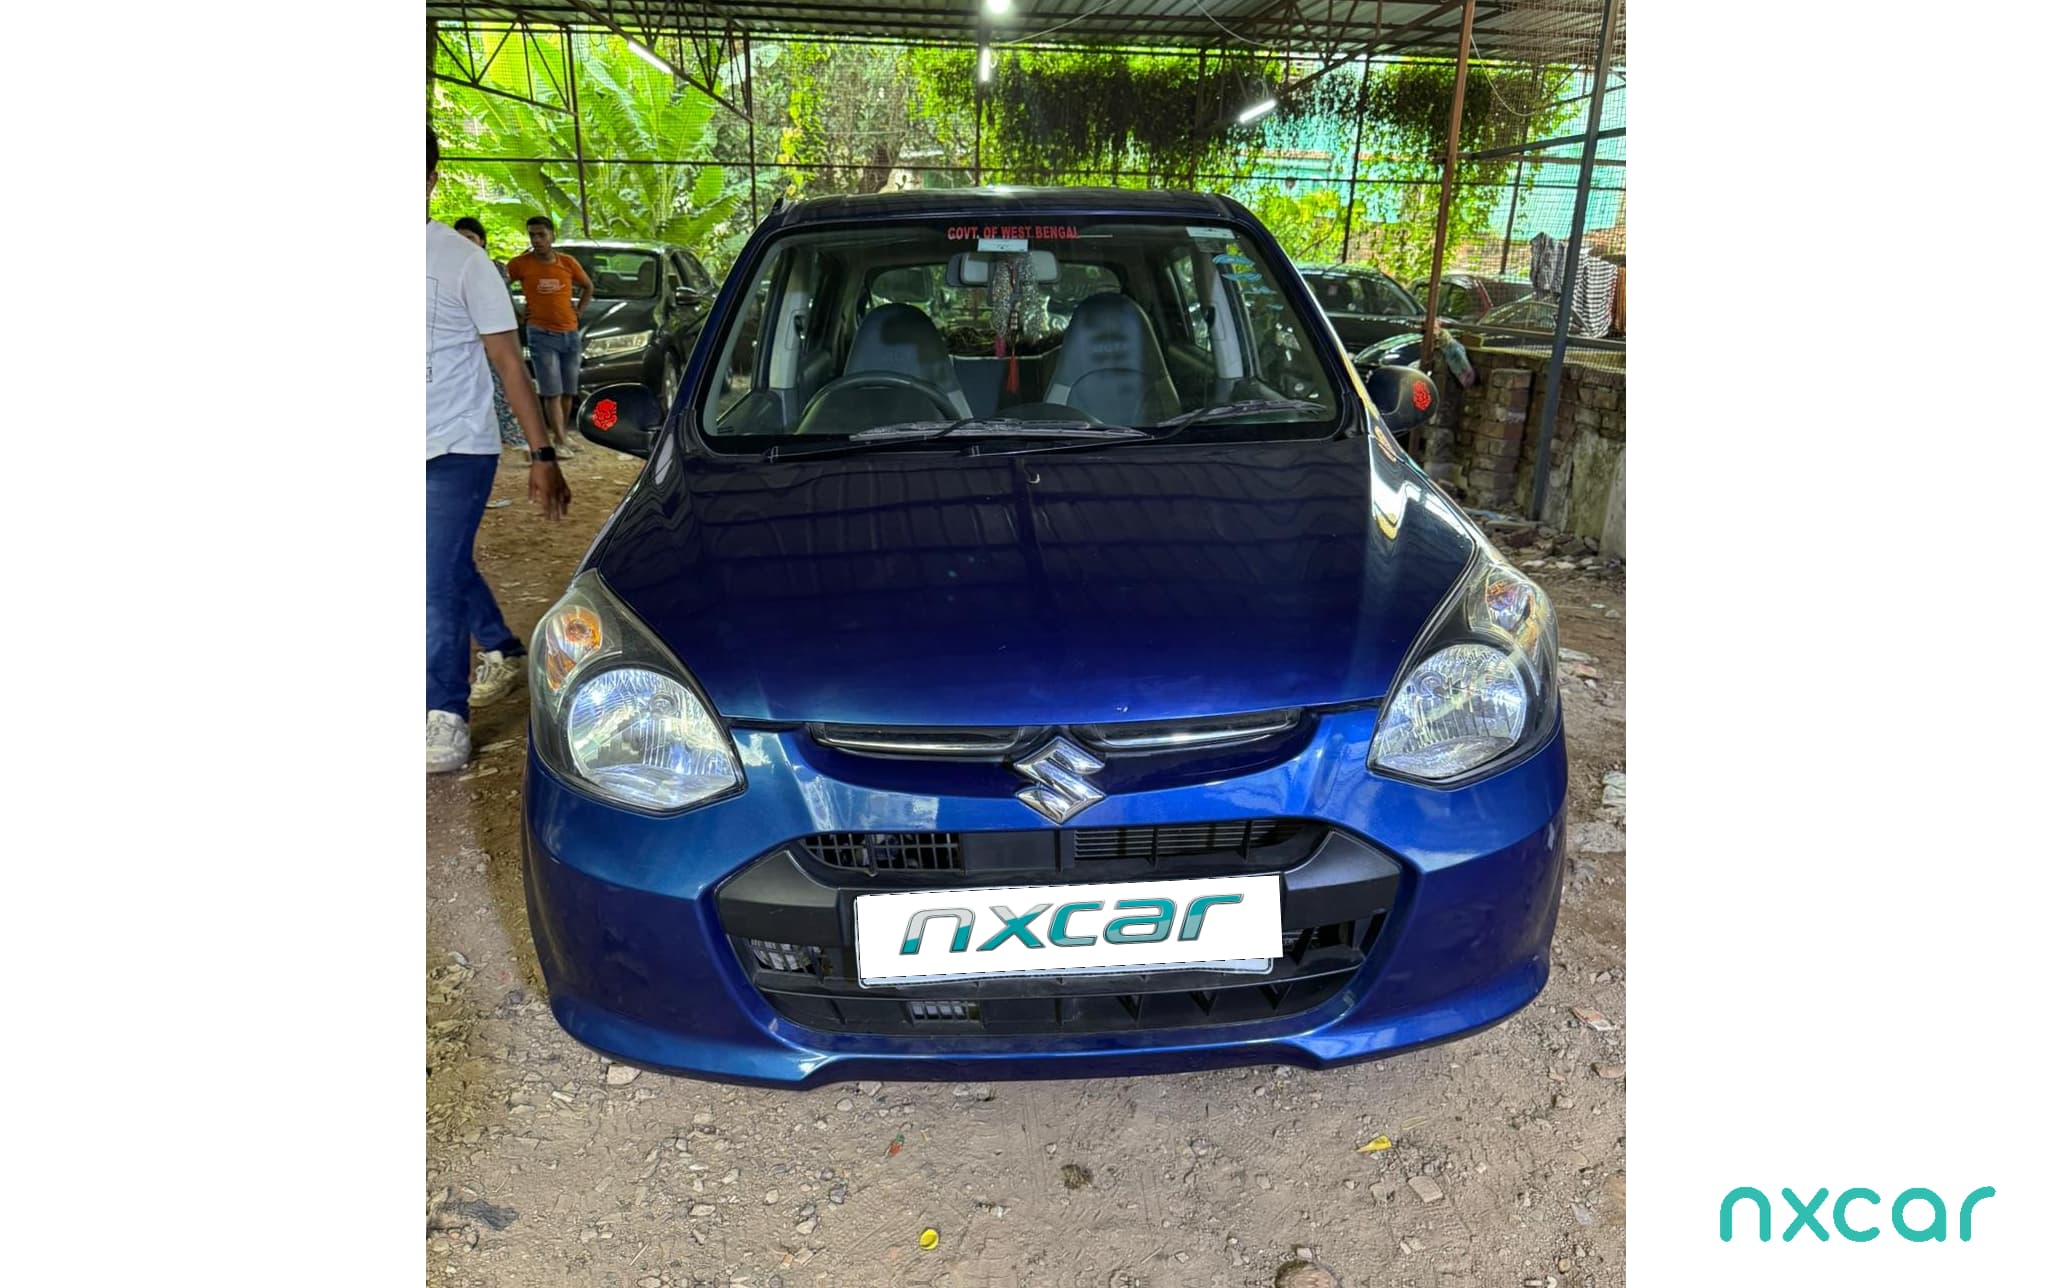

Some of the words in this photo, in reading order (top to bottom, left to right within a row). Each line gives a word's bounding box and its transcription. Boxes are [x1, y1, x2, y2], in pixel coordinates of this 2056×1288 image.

[983, 226, 998, 239] OF
[1001, 226, 1032, 239] WEST
[1035, 226, 1079, 240] BENGAL
